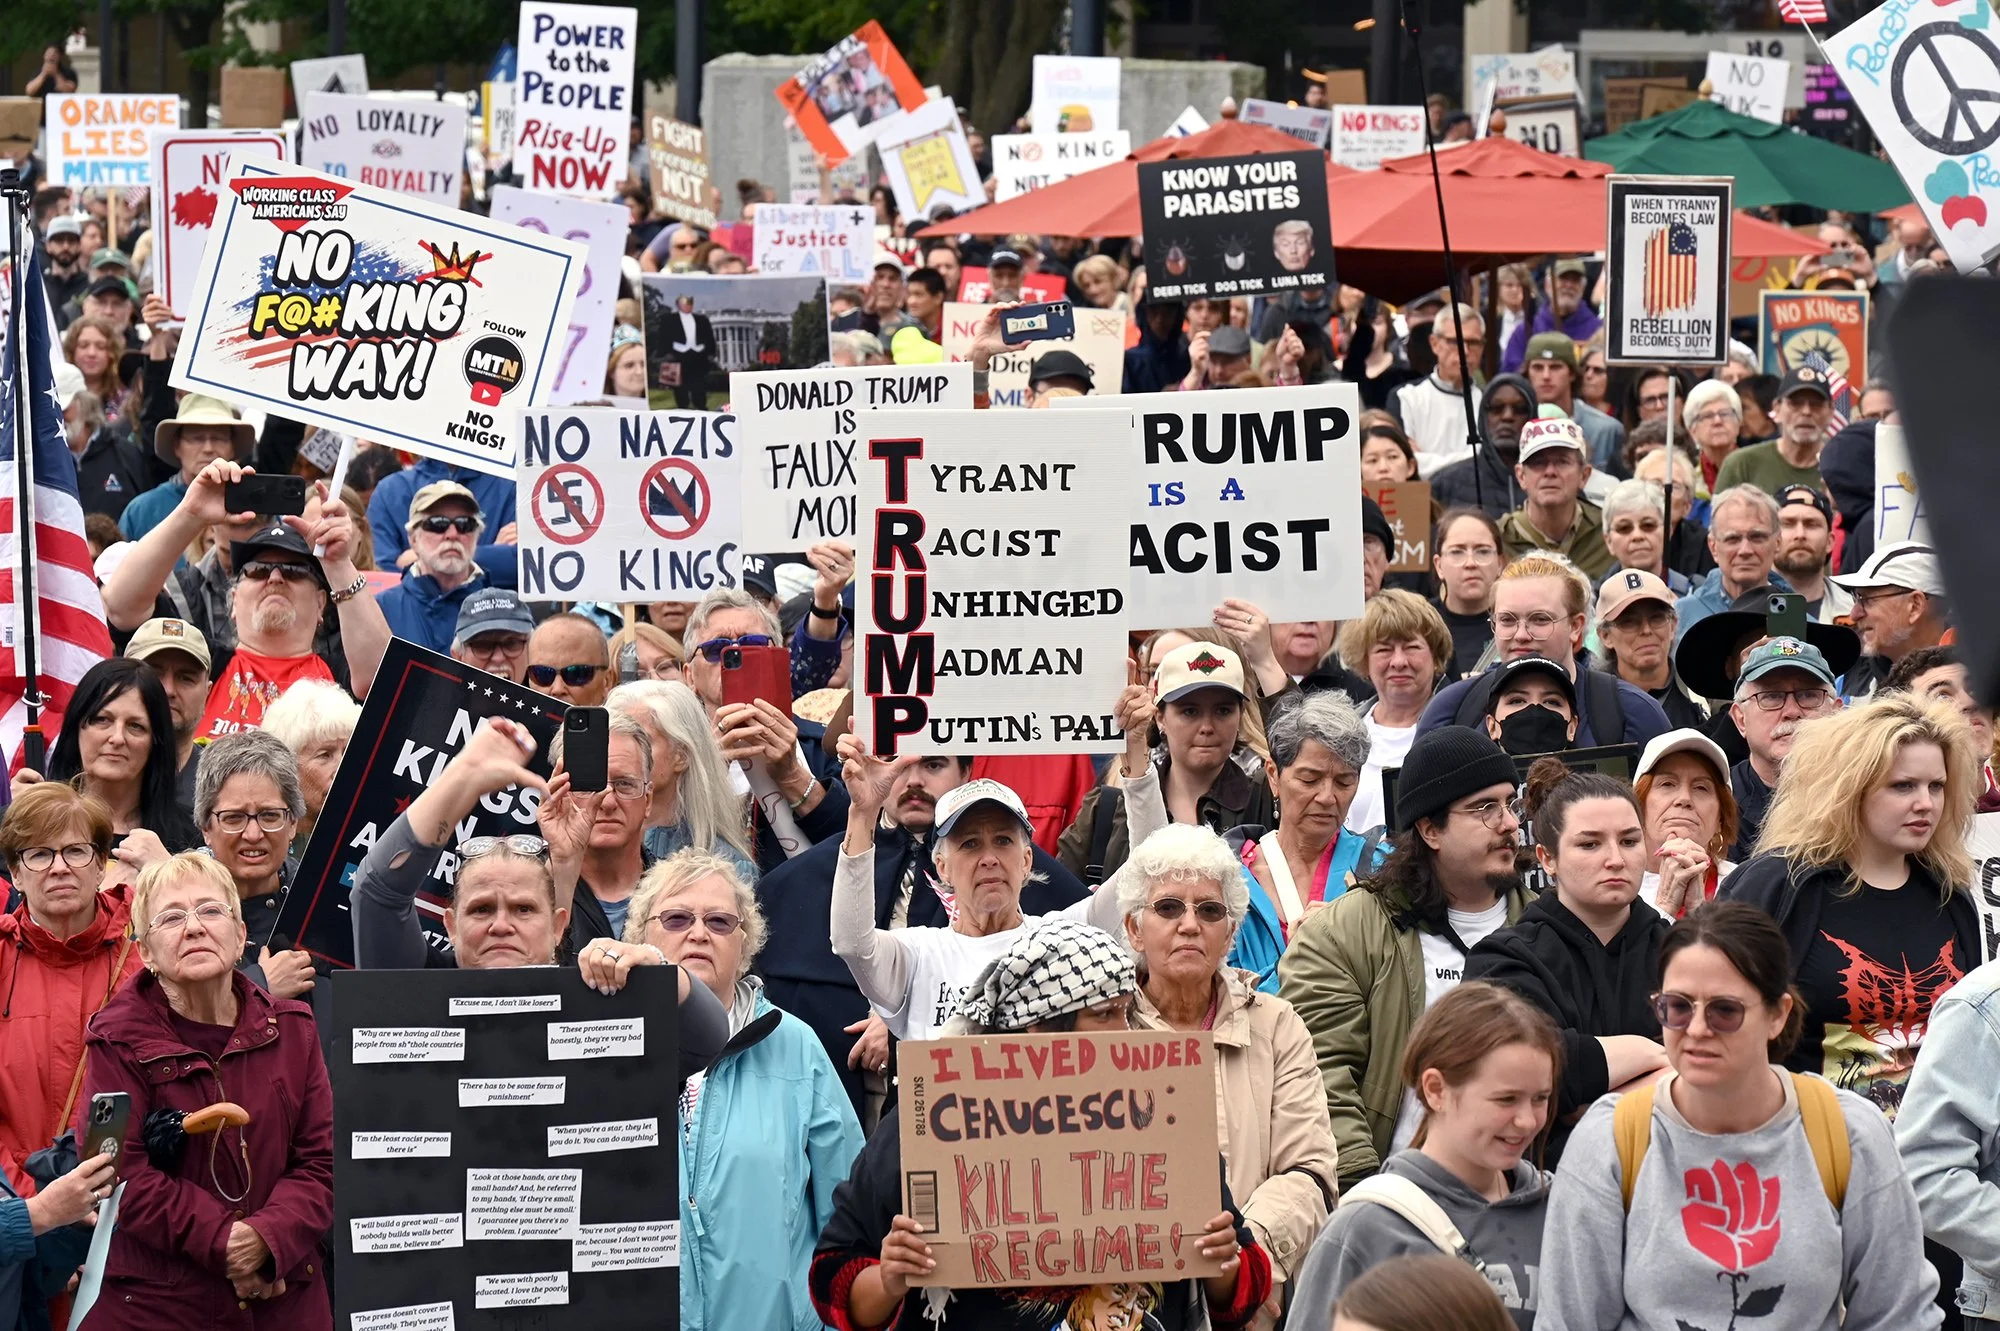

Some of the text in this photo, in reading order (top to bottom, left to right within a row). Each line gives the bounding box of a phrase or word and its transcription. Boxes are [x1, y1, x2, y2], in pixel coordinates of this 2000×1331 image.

[534, 14, 624, 49] POWER
[548, 49, 610, 72] to the
[1729, 60, 1764, 87] NO
[523, 71, 624, 110] PEOPLE
[60, 98, 175, 126] ORANGE
[309, 109, 445, 141] NO LOYALTY
[1341, 112, 1366, 131] NO
[1371, 112, 1420, 133] KINGS
[62, 130, 149, 156] LIES
[518, 120, 617, 161] Rise-Up
[651, 116, 703, 154] FIGHT
[1519, 123, 1560, 153] NO
[1057, 141, 1115, 159] KING
[63, 161, 151, 185] MATTE
[202, 155, 230, 185] N
[360, 166, 453, 195] ROYALTY
[532, 154, 611, 190] NOW
[1162, 161, 1297, 191] KNOW YOUR
[242, 186, 335, 204] WORKING CLASS
[662, 169, 703, 203] NOT
[255, 205, 347, 220] AMERICANS SAY
[1164, 186, 1300, 219] PARASITES
[1631, 198, 1717, 211] WHEN TYRANNY
[757, 208, 838, 233] Liberty
[1631, 212, 1716, 225] BECOMES LAW
[771, 229, 848, 248] Justice
[274, 231, 352, 285] NO
[761, 251, 865, 279] for ALL
[1153, 283, 1207, 298] DEER TICK
[1215, 278, 1264, 293] DOG TICK
[1272, 273, 1325, 288] LUNA TICK
[251, 282, 466, 340] F@#KING
[1774, 300, 1859, 324] NO KINGS
[483, 319, 526, 338] FOLLOW
[1630, 318, 1712, 335] REBELLION
[1630, 335, 1712, 348] BECOMES DUTY
[290, 340, 436, 400] WAY!
[470, 350, 519, 378] MTN
[757, 380, 853, 412] DONALD
[866, 375, 949, 409] TRUMP
[467, 410, 493, 429] NO
[835, 410, 856, 435] IS
[446, 421, 505, 450] KINGS!
[525, 415, 736, 466] NO NAZIS
[1131, 407, 1350, 464] RUMP
[765, 440, 856, 489] FAUX
[869, 438, 1076, 504] TYRANT
[1148, 478, 1245, 506] IS A
[873, 508, 1060, 572] RACIST
[1130, 519, 1330, 574] ACIST
[523, 543, 738, 594] NO KINGS
[1626, 572, 1642, 590] B
[872, 573, 1124, 634] UNHINGED
[865, 633, 1083, 697] MADMAN
[445, 708, 490, 747] N
[1050, 715, 1125, 742] PAL
[403, 1030, 429, 1038] having
[583, 1023, 619, 1033] protesters
[354, 1040, 378, 1049] people
[930, 1038, 1202, 1083] I LIVED UNDER
[913, 1076, 926, 1136] SKU 261788
[929, 1085, 1176, 1142] CEAUCESCU:
[954, 1150, 1168, 1234] KILL THE
[970, 1222, 1185, 1283] REGIME!
